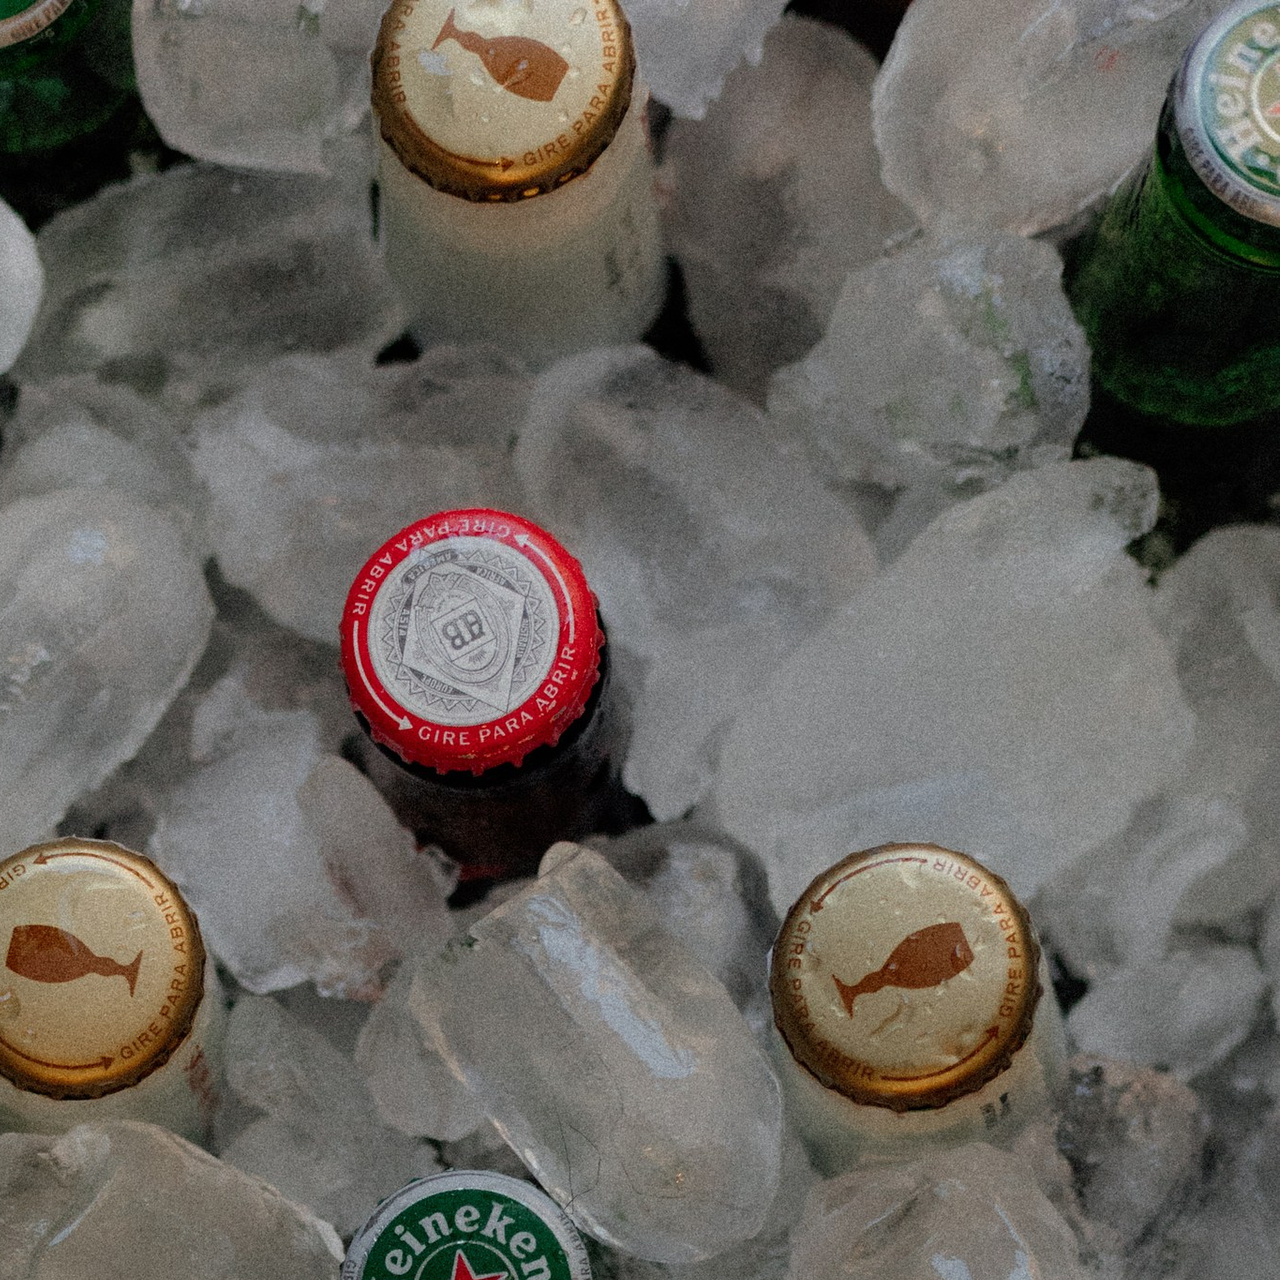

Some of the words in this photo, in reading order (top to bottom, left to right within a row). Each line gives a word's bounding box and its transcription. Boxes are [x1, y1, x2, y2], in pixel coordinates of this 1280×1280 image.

[522, 132, 571, 166] GIRE
[572, 83, 611, 136] PARA
[594, 7, 618, 75] ABRIR
[1208, 20, 1280, 160] Heine
[394, 521, 449, 553] PARA
[352, 550, 394, 615] ABRIR
[416, 723, 469, 746] GIRE
[479, 709, 534, 742] PARA
[532, 646, 575, 712] ABRIR
[932, 856, 993, 901] ABRIR
[153, 890, 185, 952] ABRIR
[990, 902, 1021, 959] PARA
[158, 964, 186, 1020] PARA
[997, 969, 1020, 1019] GIRE
[117, 1021, 163, 1062] GIRE
